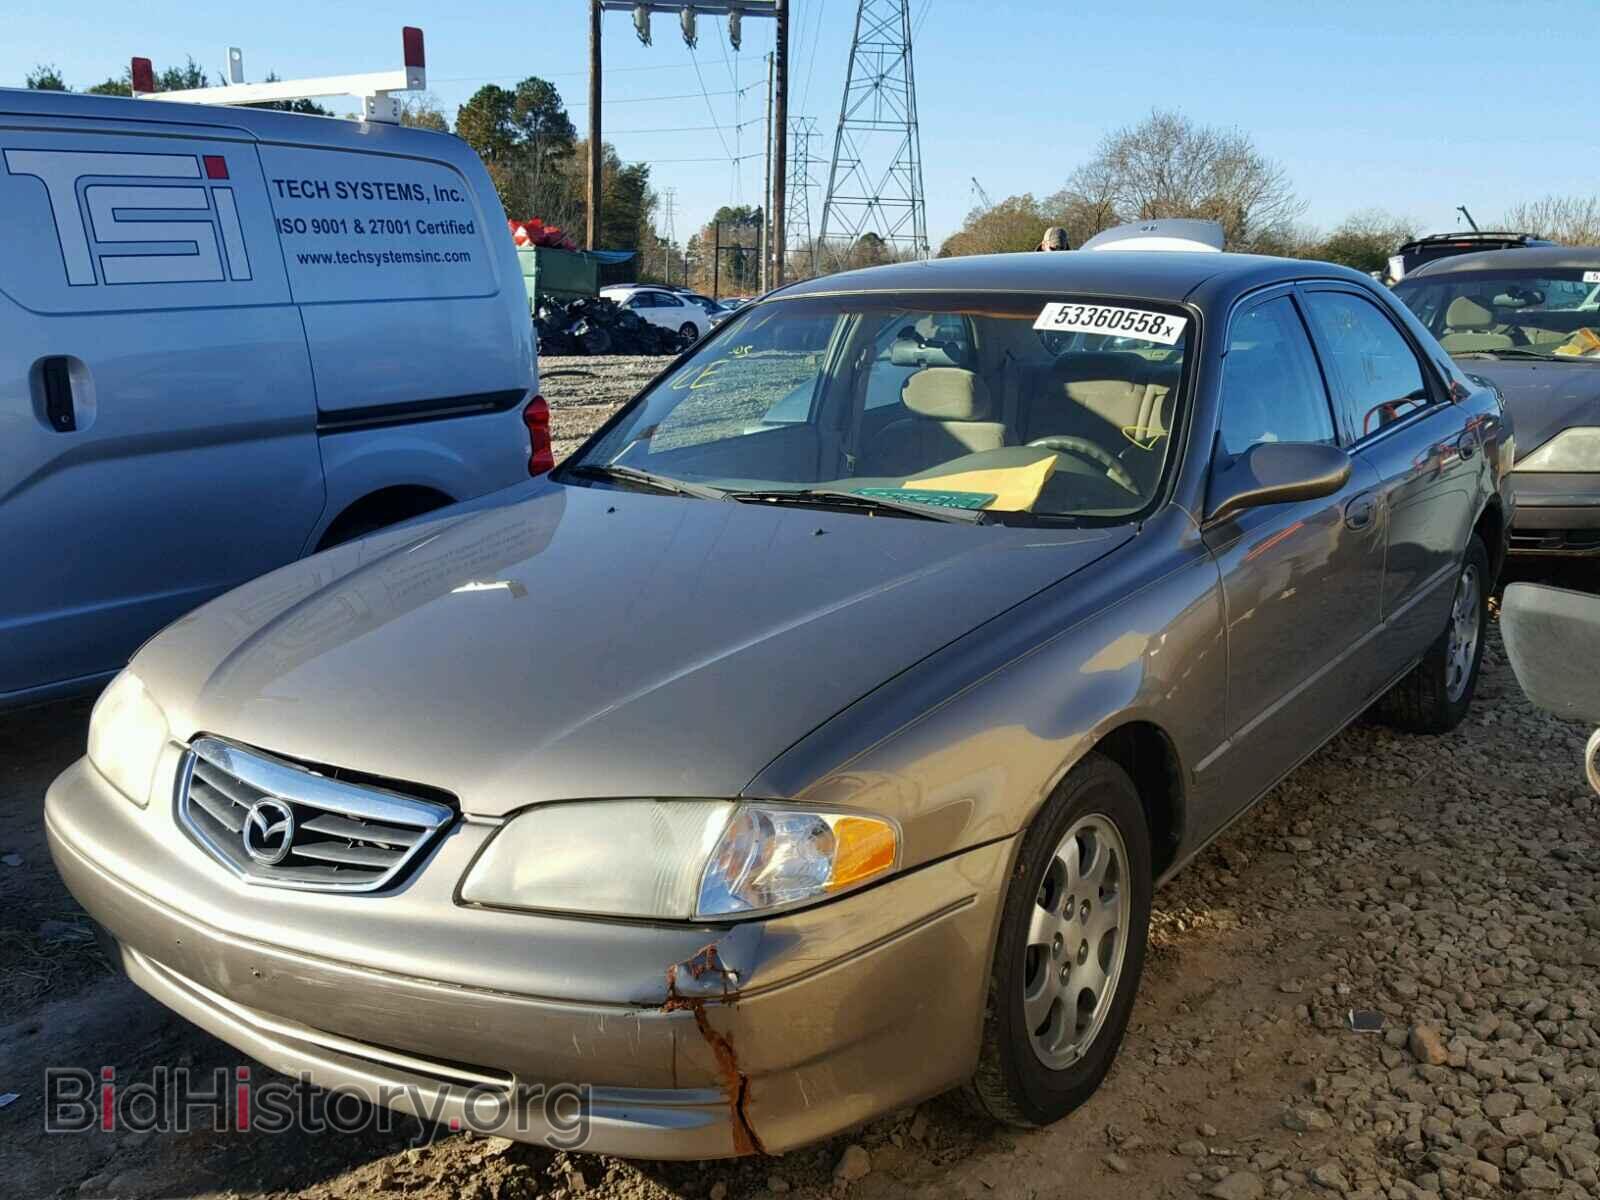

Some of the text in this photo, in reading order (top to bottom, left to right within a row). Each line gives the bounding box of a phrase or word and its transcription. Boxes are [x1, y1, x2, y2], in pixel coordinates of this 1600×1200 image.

[272, 179, 465, 205] TECH SYSTEMS, Inc.
[276, 217, 475, 235] ISO 9001 & 27001 Certified
[297, 249, 472, 267] www.techsystemsinc.com
